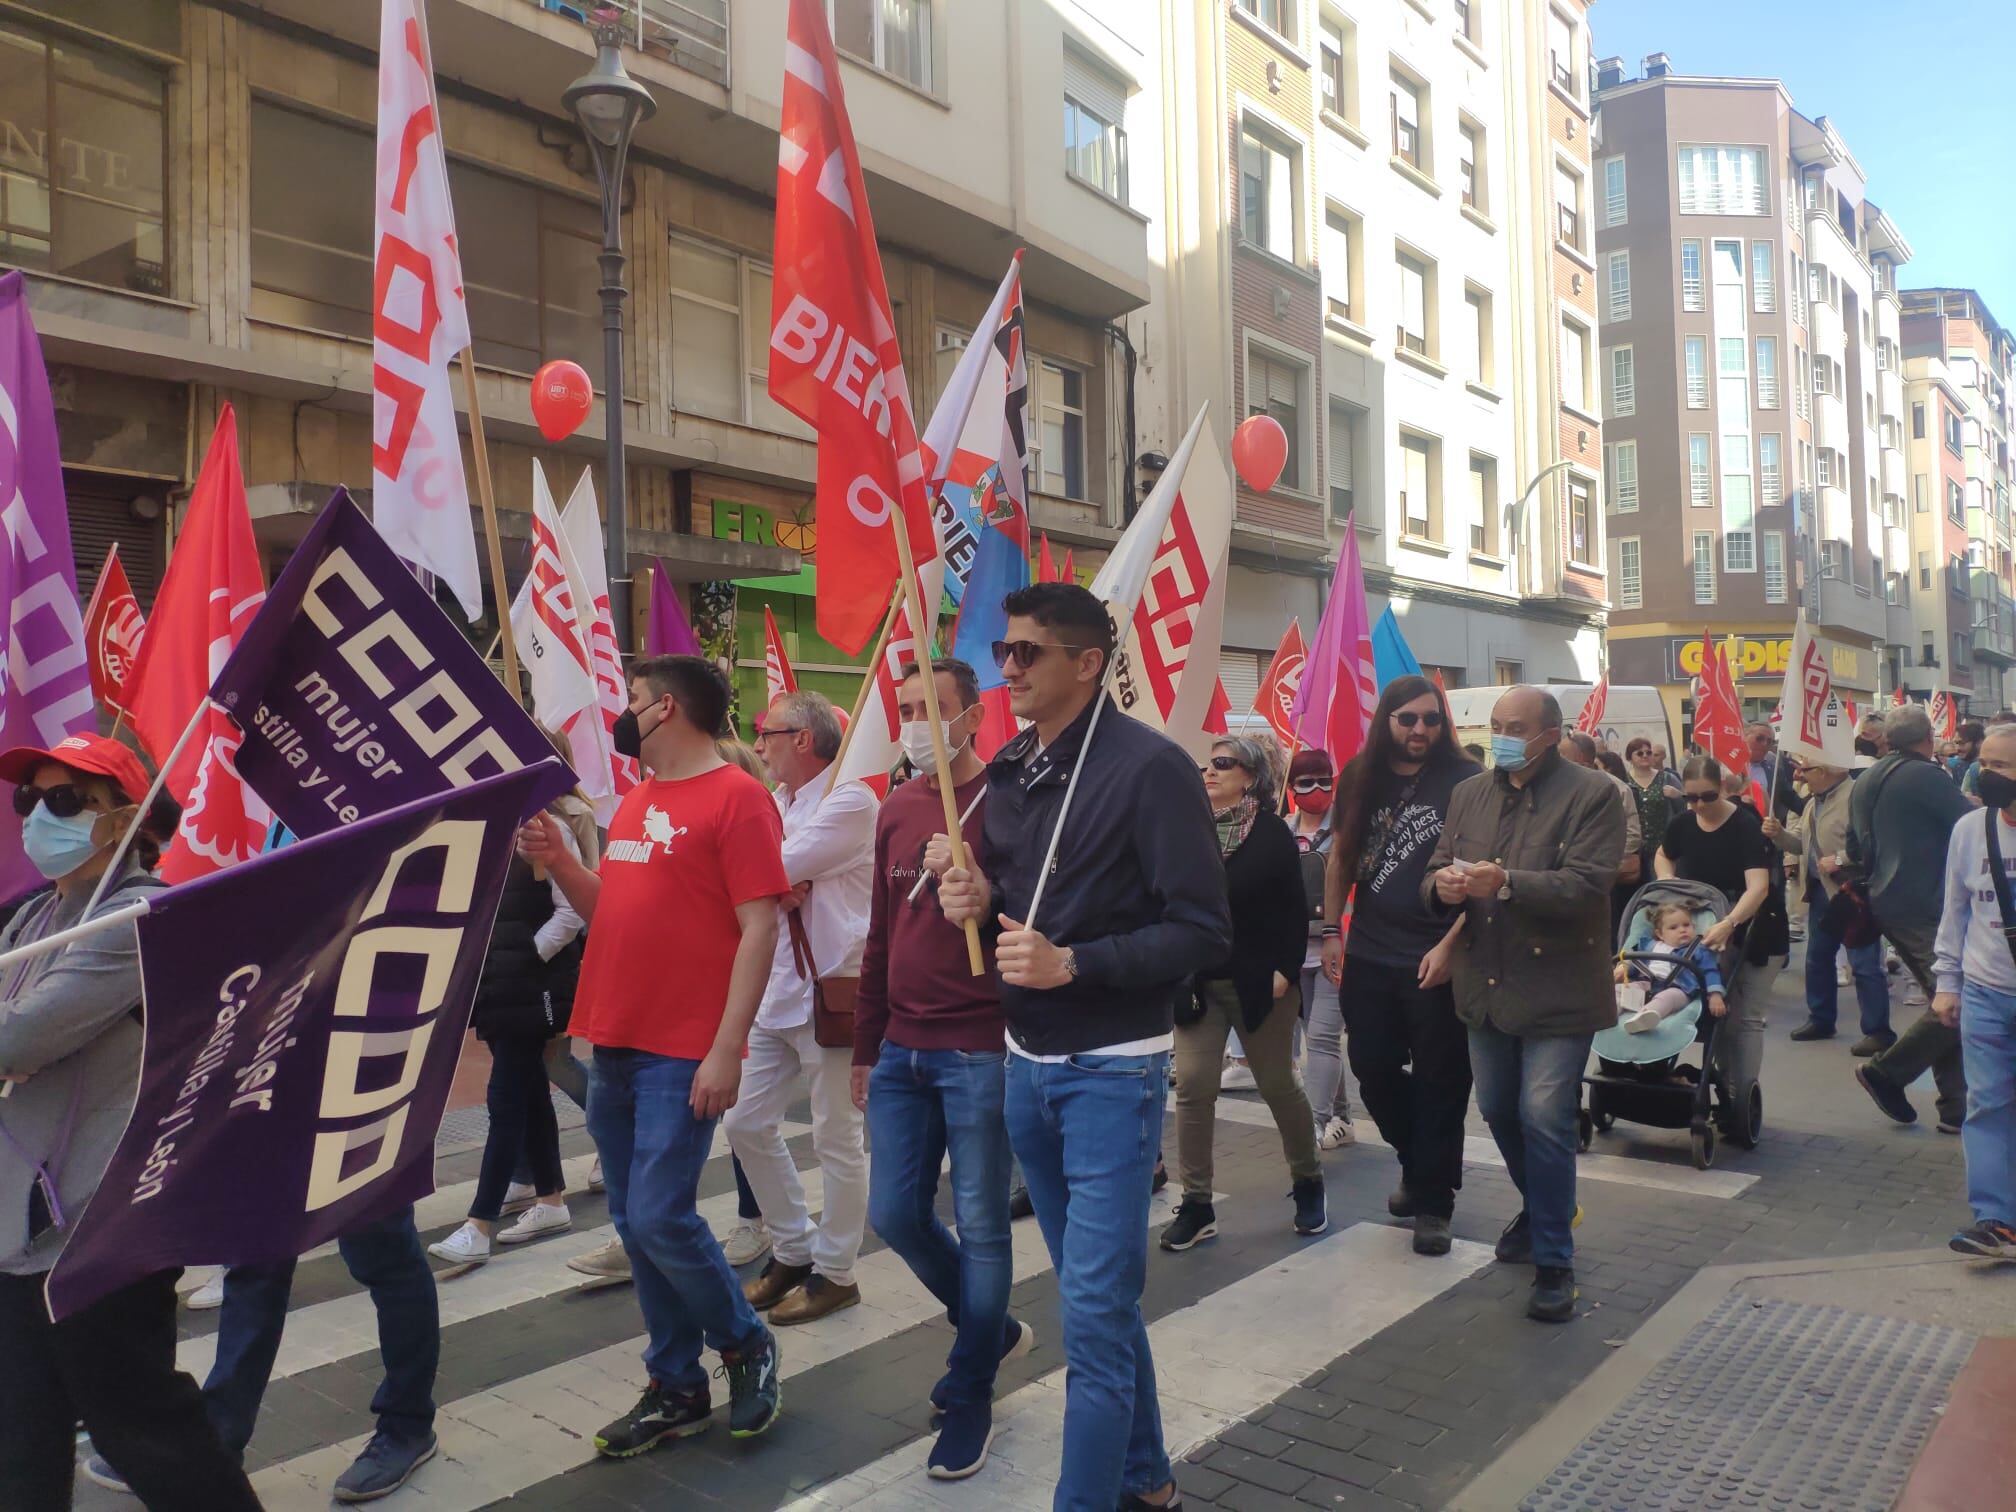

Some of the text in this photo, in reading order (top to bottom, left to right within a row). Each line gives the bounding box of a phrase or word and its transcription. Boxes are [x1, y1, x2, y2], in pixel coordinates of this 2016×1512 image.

[296, 671, 403, 780] mujer
[890, 865, 916, 877] Calvin
[1385, 841, 1396, 857] of
[1412, 810, 1440, 830] best
[1397, 841, 1416, 860] are
[176, 964, 261, 1102] Castilla
[229, 970, 315, 1111] mujer
[131, 1117, 194, 1205] León
